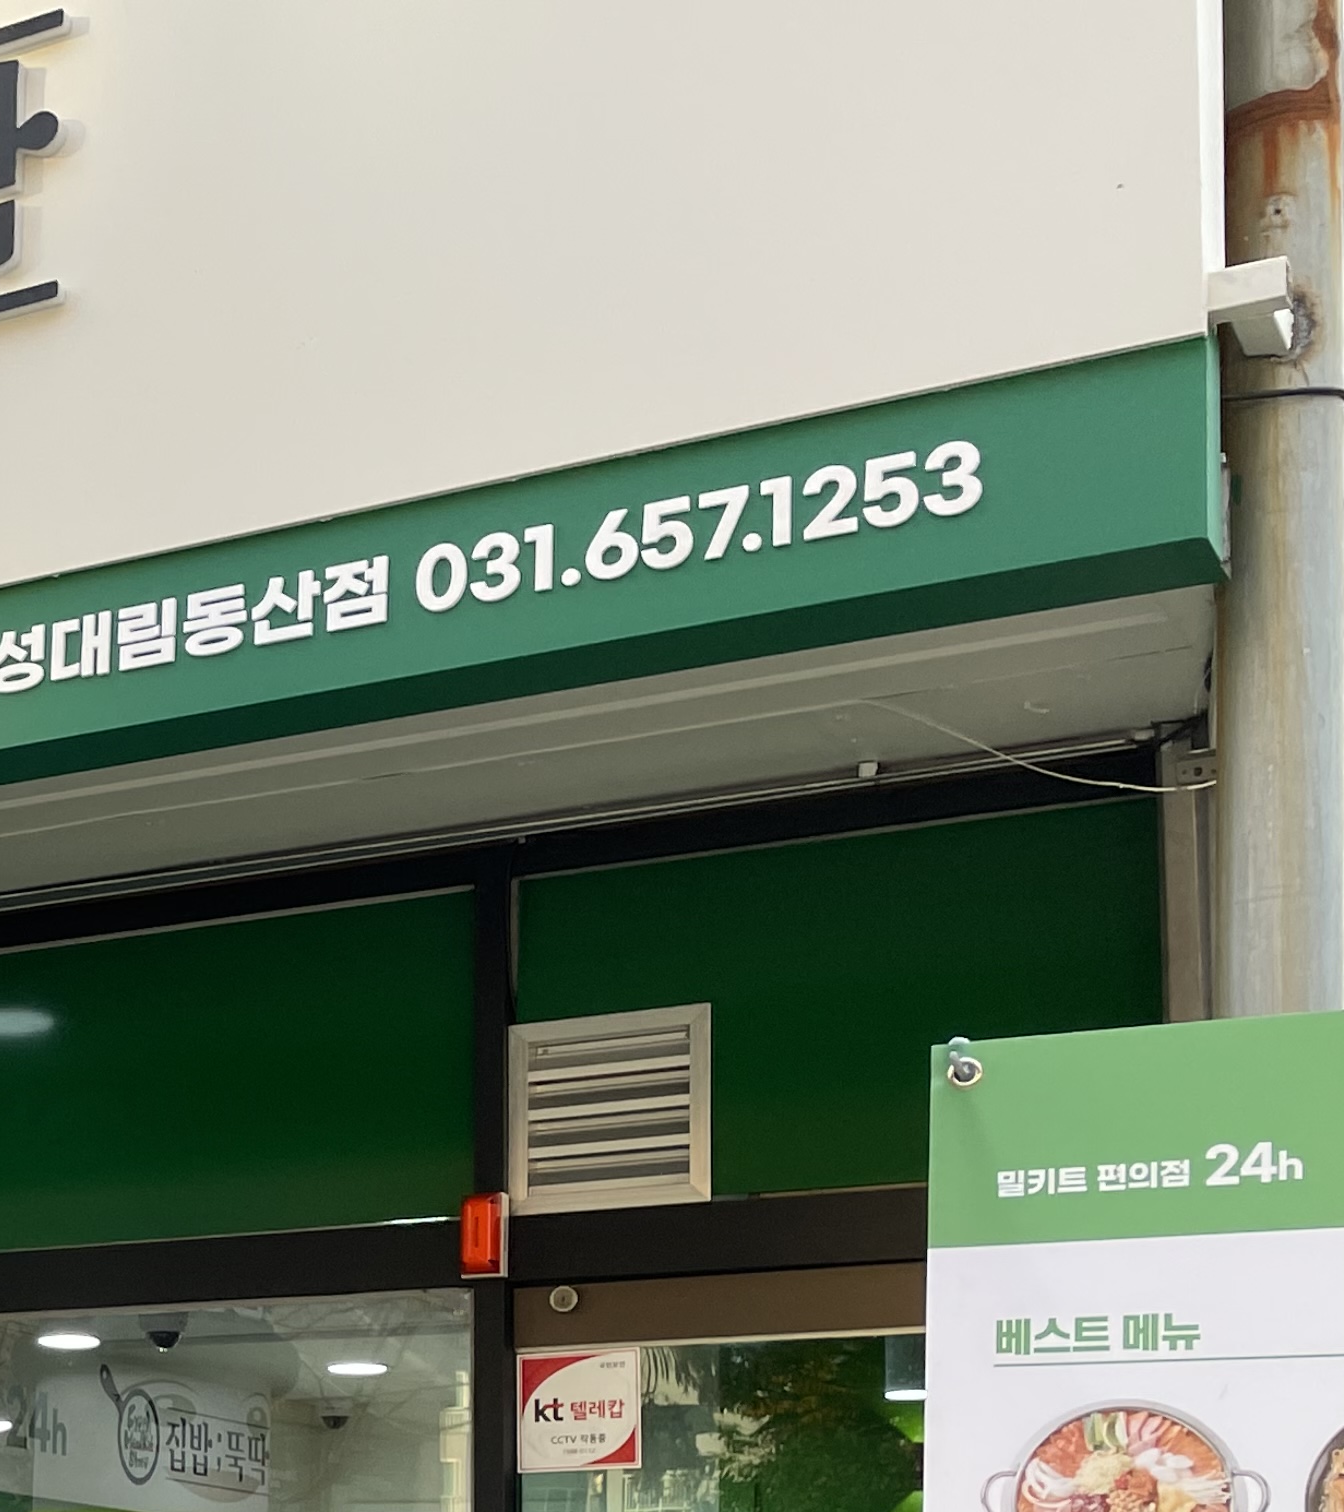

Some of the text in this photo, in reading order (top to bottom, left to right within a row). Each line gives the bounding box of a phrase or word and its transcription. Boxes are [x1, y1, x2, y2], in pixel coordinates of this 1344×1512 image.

[415, 441, 985, 614] 031.657.1253
[997, 1141, 1304, 1198] 밀키트 편의점 24h
[995, 1312, 1201, 1355] 베스트 메뉴
[6, 1384, 68, 1457] 24h
[534, 1398, 625, 1422] kt 텔레캅
[551, 1435, 577, 1444] CCTV
